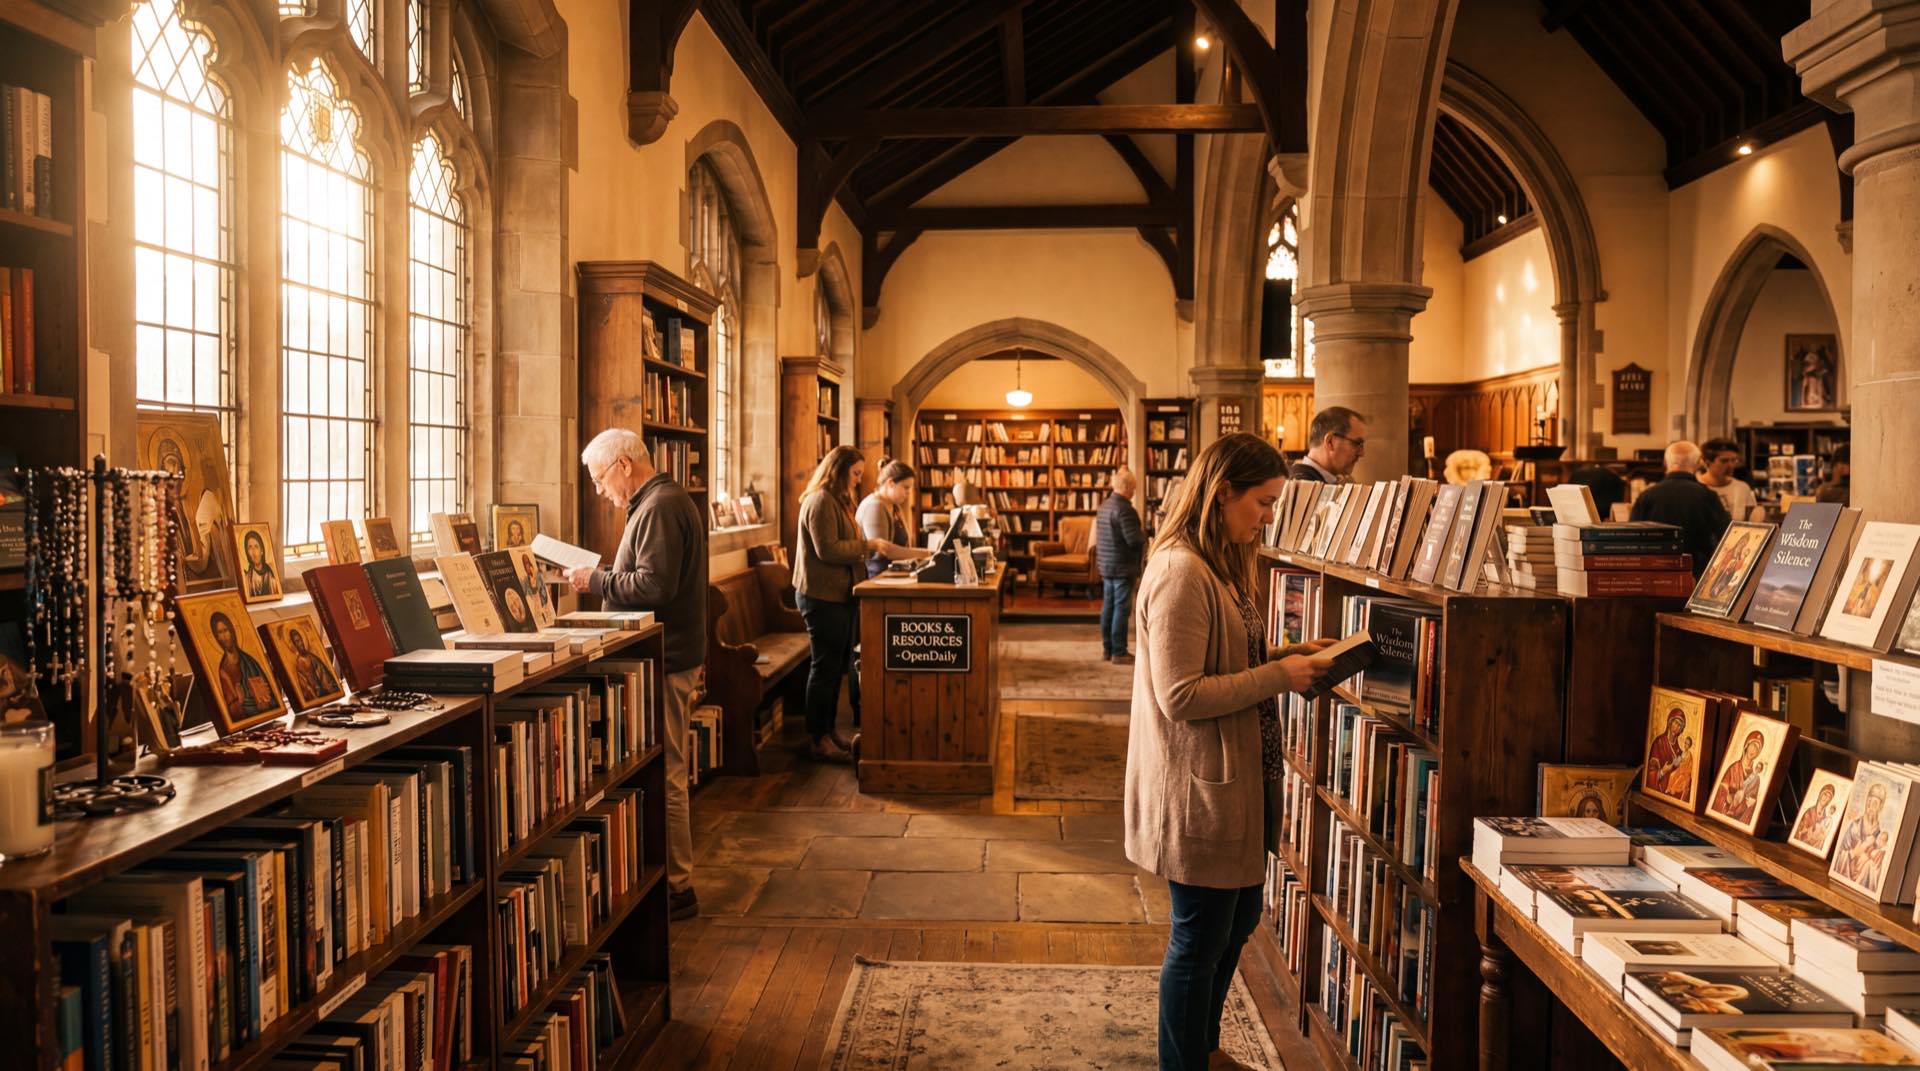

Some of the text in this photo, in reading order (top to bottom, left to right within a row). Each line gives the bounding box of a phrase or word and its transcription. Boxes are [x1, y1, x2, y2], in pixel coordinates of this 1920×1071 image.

[1798, 519, 1813, 530] The
[1780, 533, 1819, 549] Wisdom
[1774, 550, 1812, 567] Silence
[901, 622, 955, 633] BOOKS &
[1392, 627, 1403, 636] The
[892, 635, 963, 647] RESOURCES
[1376, 632, 1413, 649] Wisdom
[1380, 645, 1413, 660] Silence
